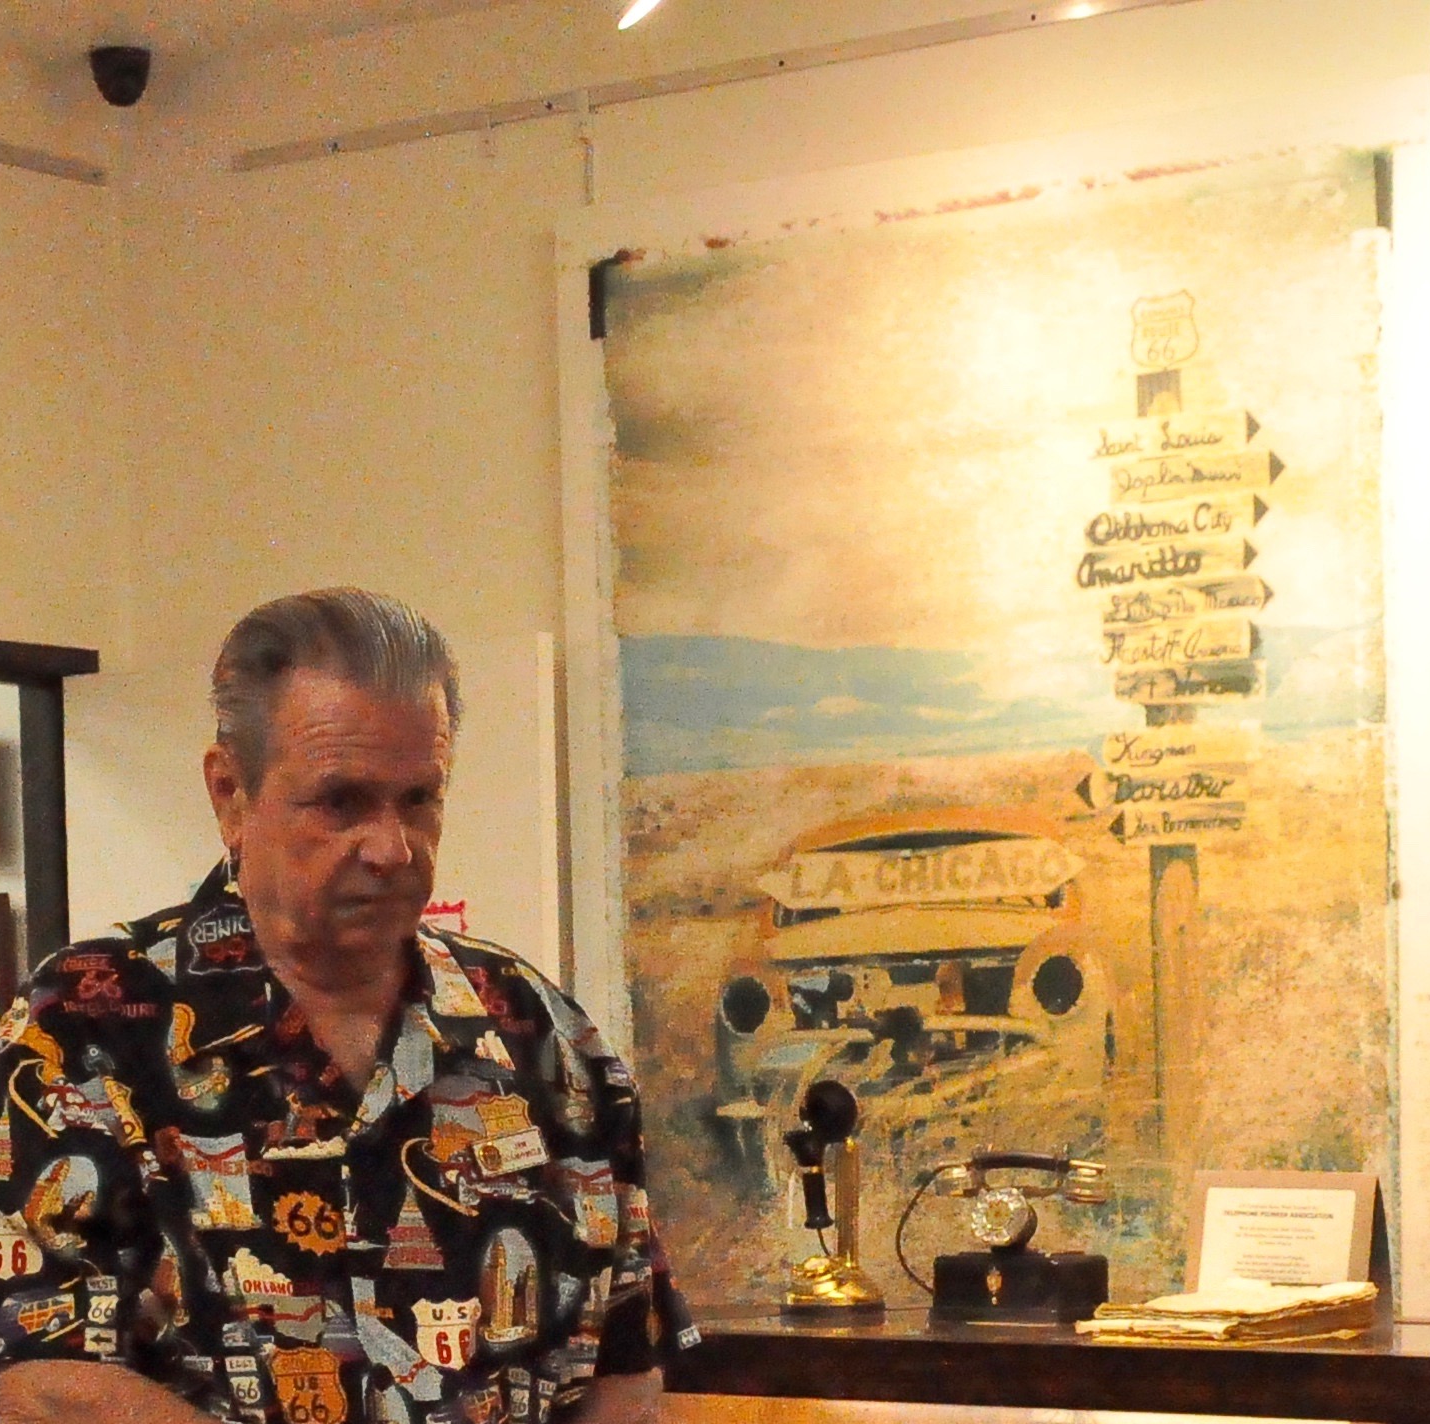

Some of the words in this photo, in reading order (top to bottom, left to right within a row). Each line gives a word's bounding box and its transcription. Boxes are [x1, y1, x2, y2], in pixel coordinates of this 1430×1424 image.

[1084, 511, 1190, 546] Oklahoma
[1193, 502, 1234, 533] City
[287, 1201, 341, 1240] 66
[91, 1301, 115, 1320] 66
[235, 1380, 259, 1400] 66
[293, 1376, 320, 1391] US
[289, 1393, 329, 1424] 66
